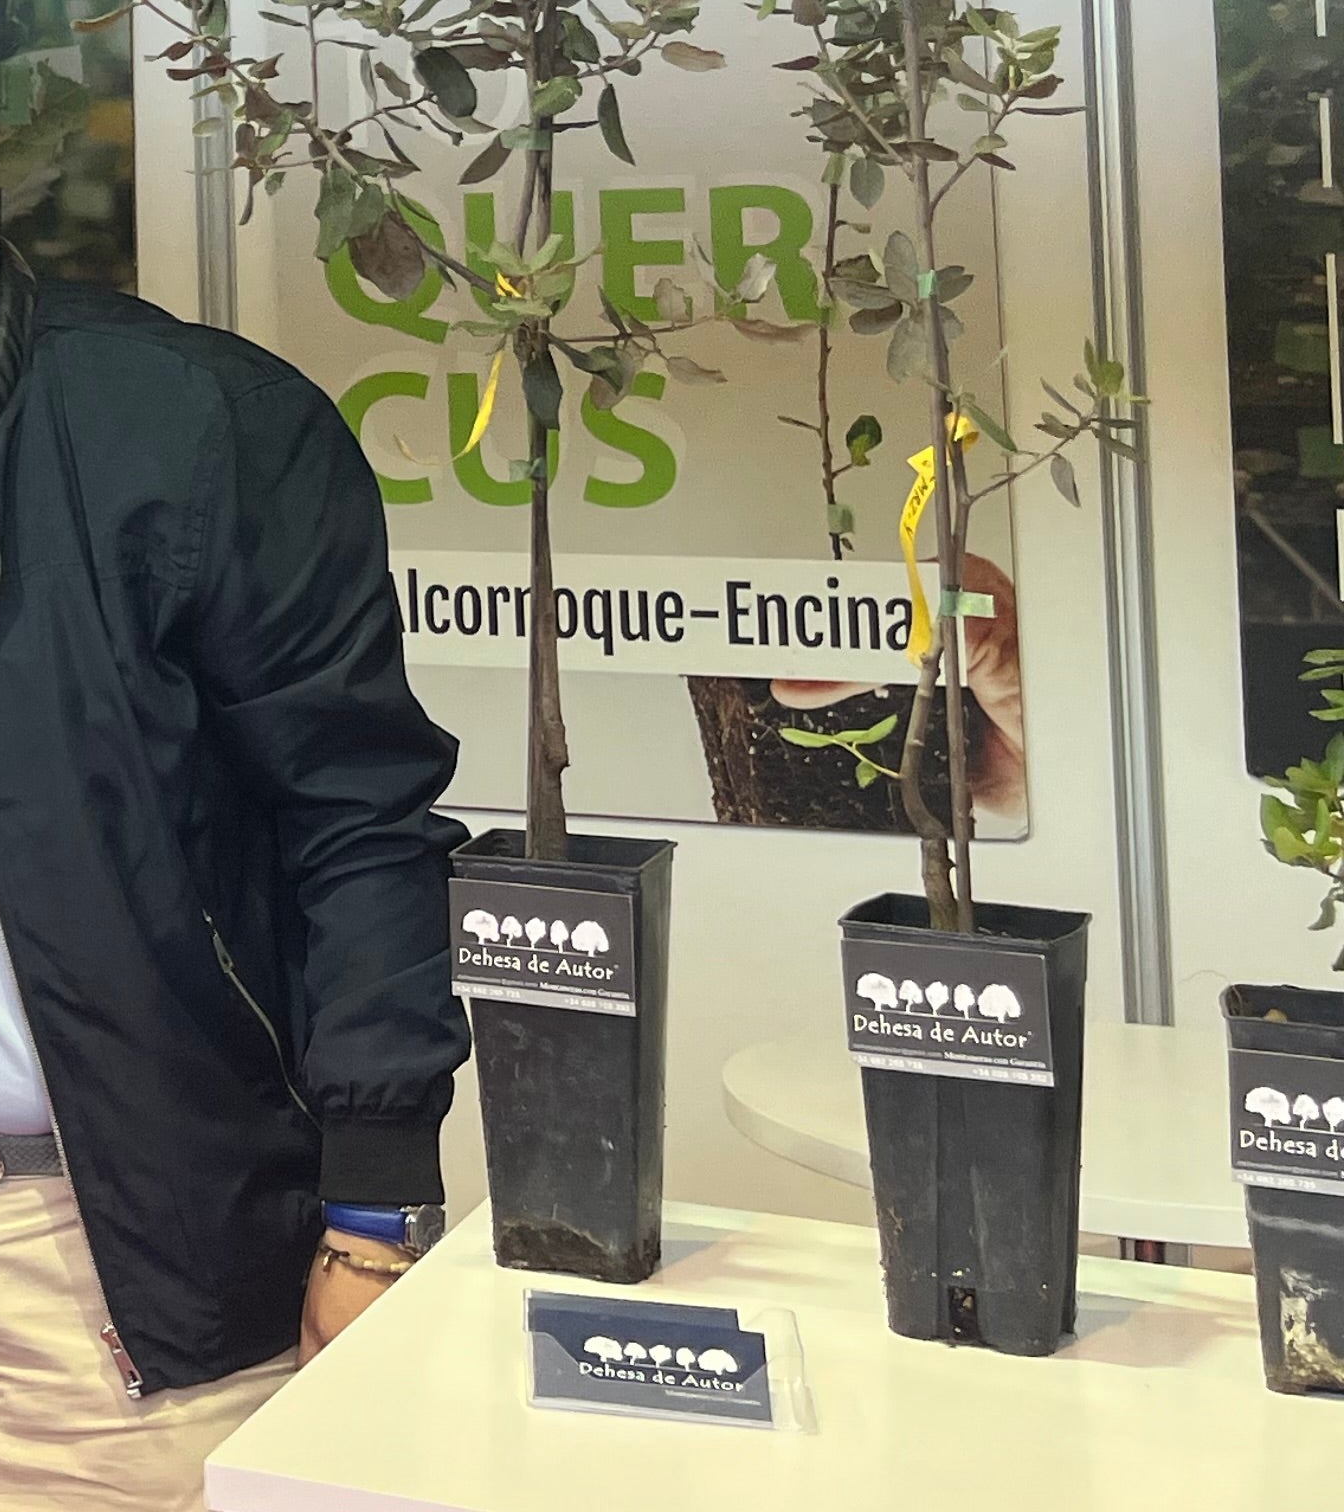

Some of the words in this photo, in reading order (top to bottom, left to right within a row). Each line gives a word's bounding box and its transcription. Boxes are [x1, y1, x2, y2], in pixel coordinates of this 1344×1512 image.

[323, 184, 831, 345] QUER
[335, 370, 677, 509] CUS
[458, 947, 522, 972] Dehesa
[527, 954, 550, 974] de
[555, 958, 615, 981] Autor
[852, 1013, 923, 1040] Dehesa
[929, 1021, 955, 1043] de
[960, 1025, 1029, 1049] Autor
[1239, 1129, 1317, 1159] Dehesa
[578, 1361, 646, 1383] Dehesa
[652, 1371, 677, 1386] de
[681, 1373, 745, 1393] Autor
